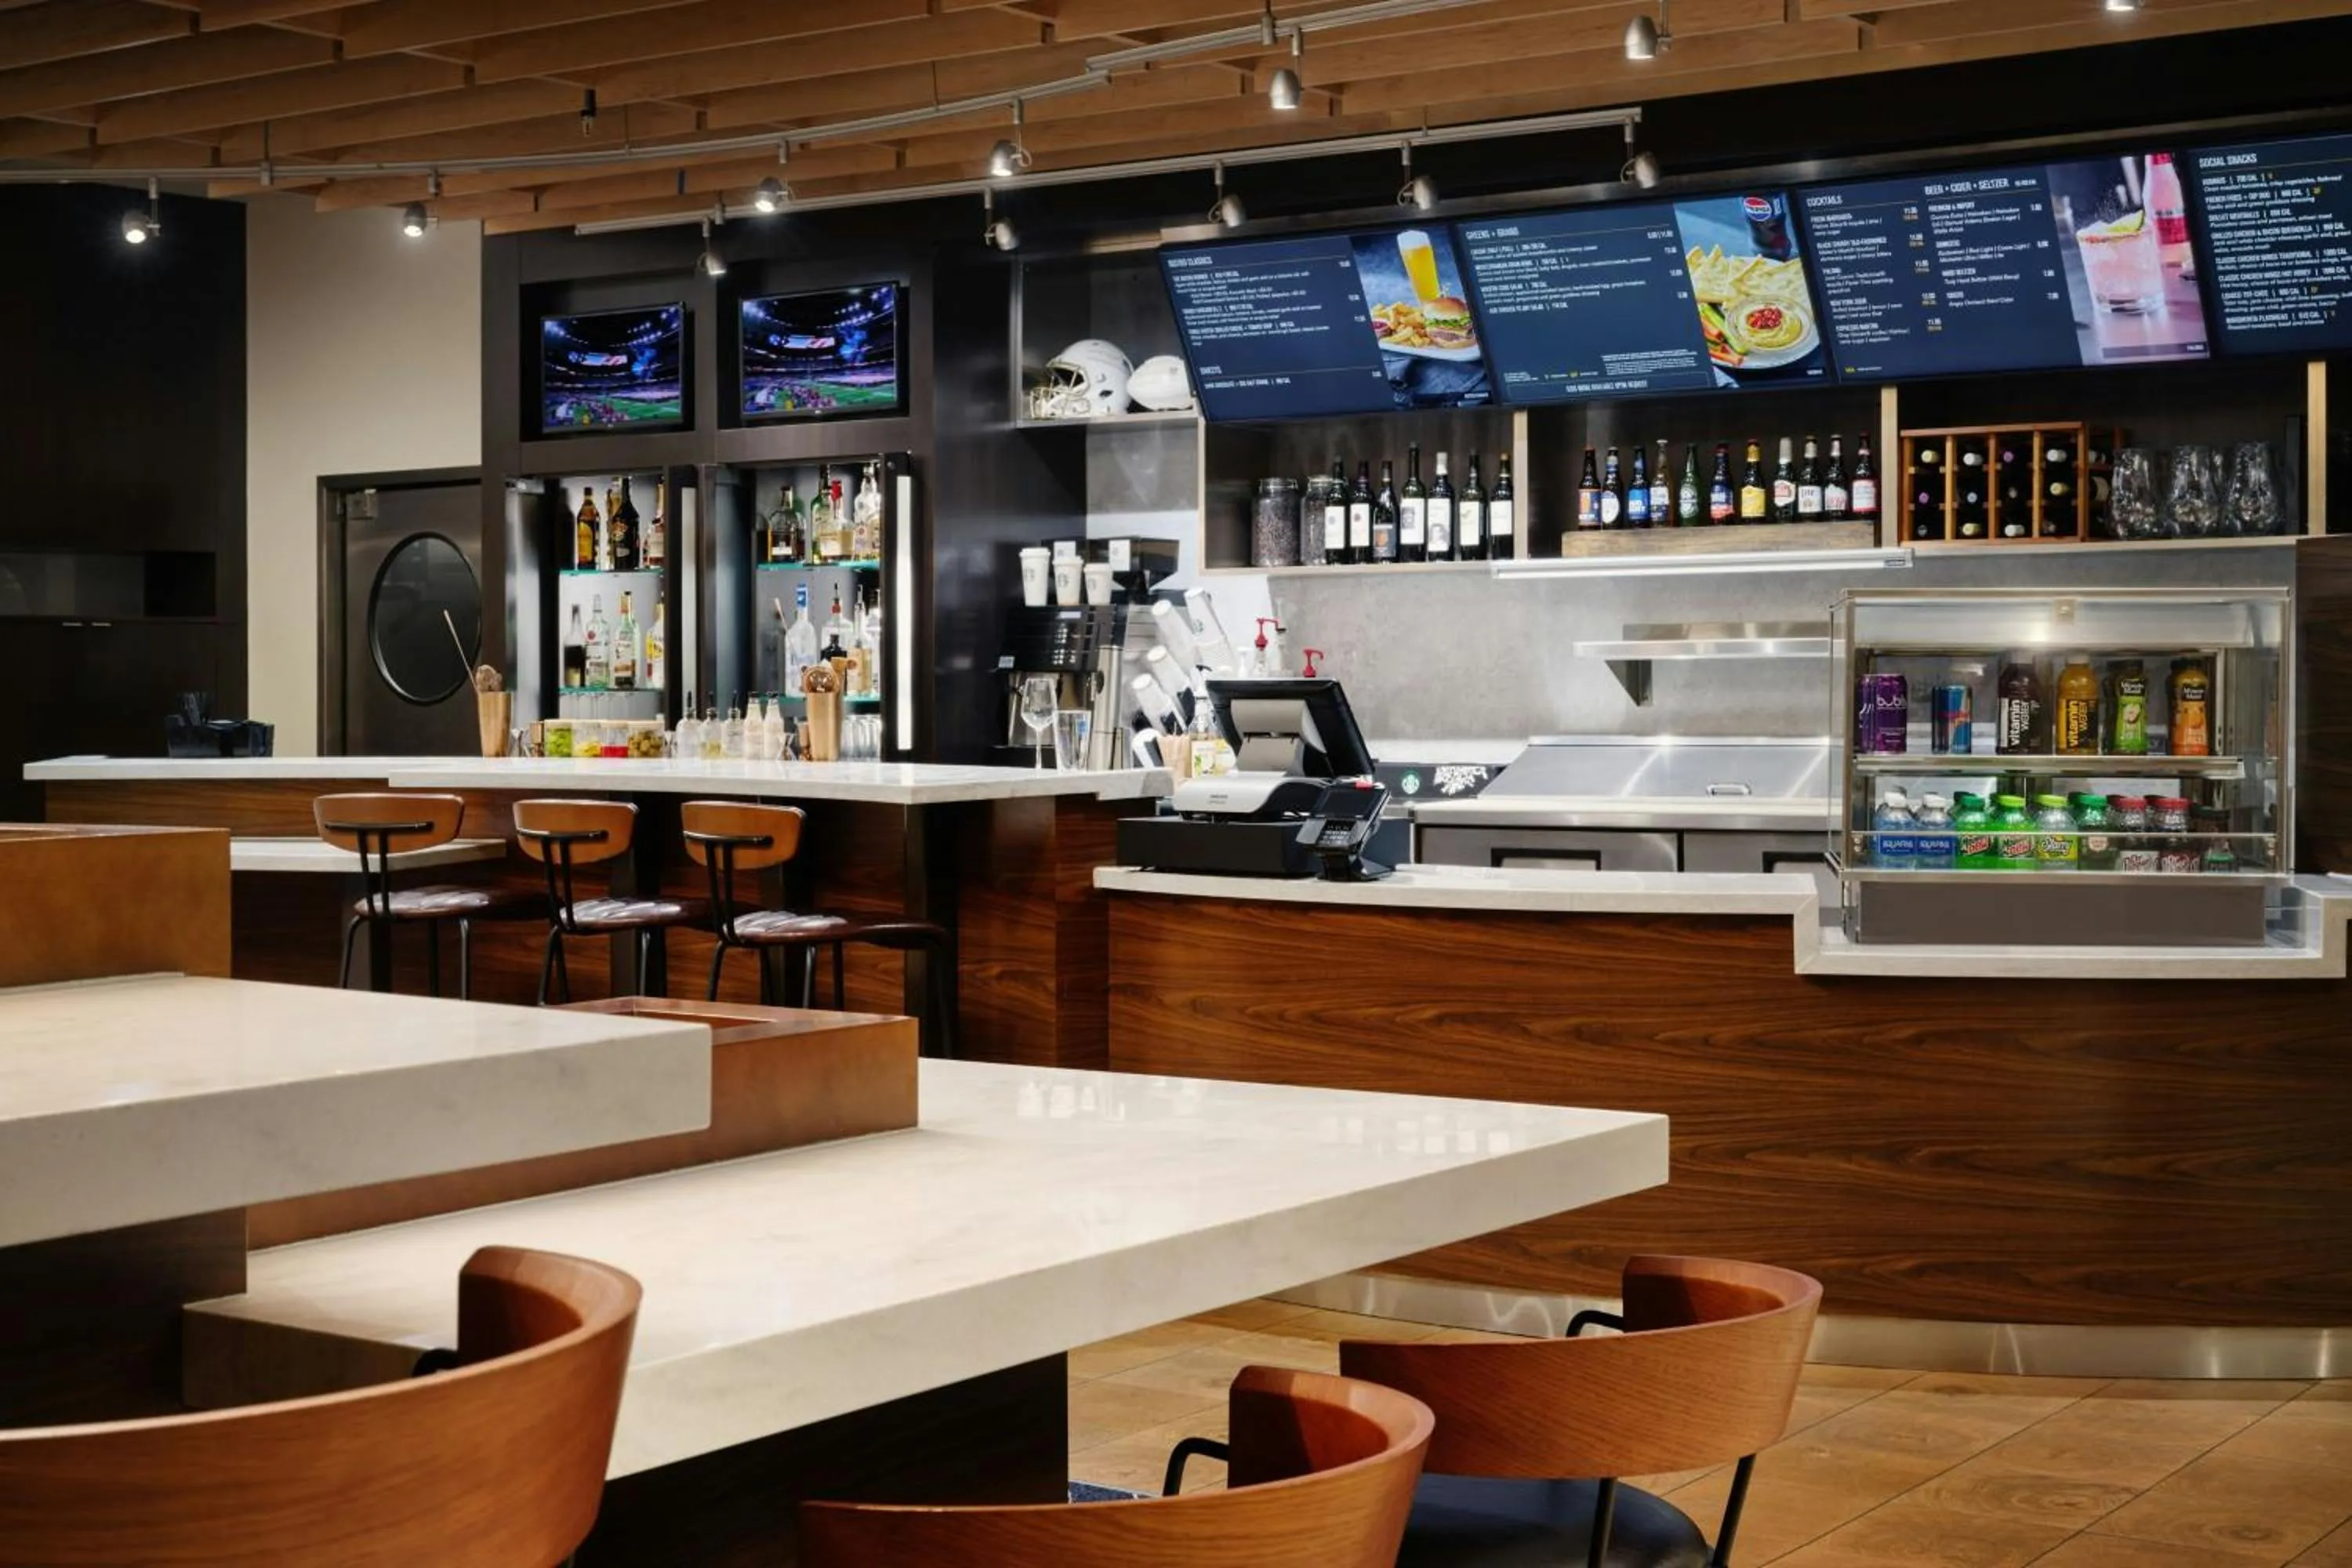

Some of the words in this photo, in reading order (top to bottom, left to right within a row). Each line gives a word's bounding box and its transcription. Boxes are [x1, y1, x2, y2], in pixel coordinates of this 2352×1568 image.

[2199, 157, 2225, 168] SOCIAL
[2227, 154, 2257, 165] SNACKS
[1924, 185, 1944, 194] BEER
[1950, 182, 1973, 192] CIDER
[1978, 179, 2009, 190] SELTZER
[1806, 196, 1843, 207] COCKTAILS
[1876, 694, 1907, 706] bub
[2009, 699, 2021, 746] vitamin
[2067, 699, 2080, 747] vitamin
